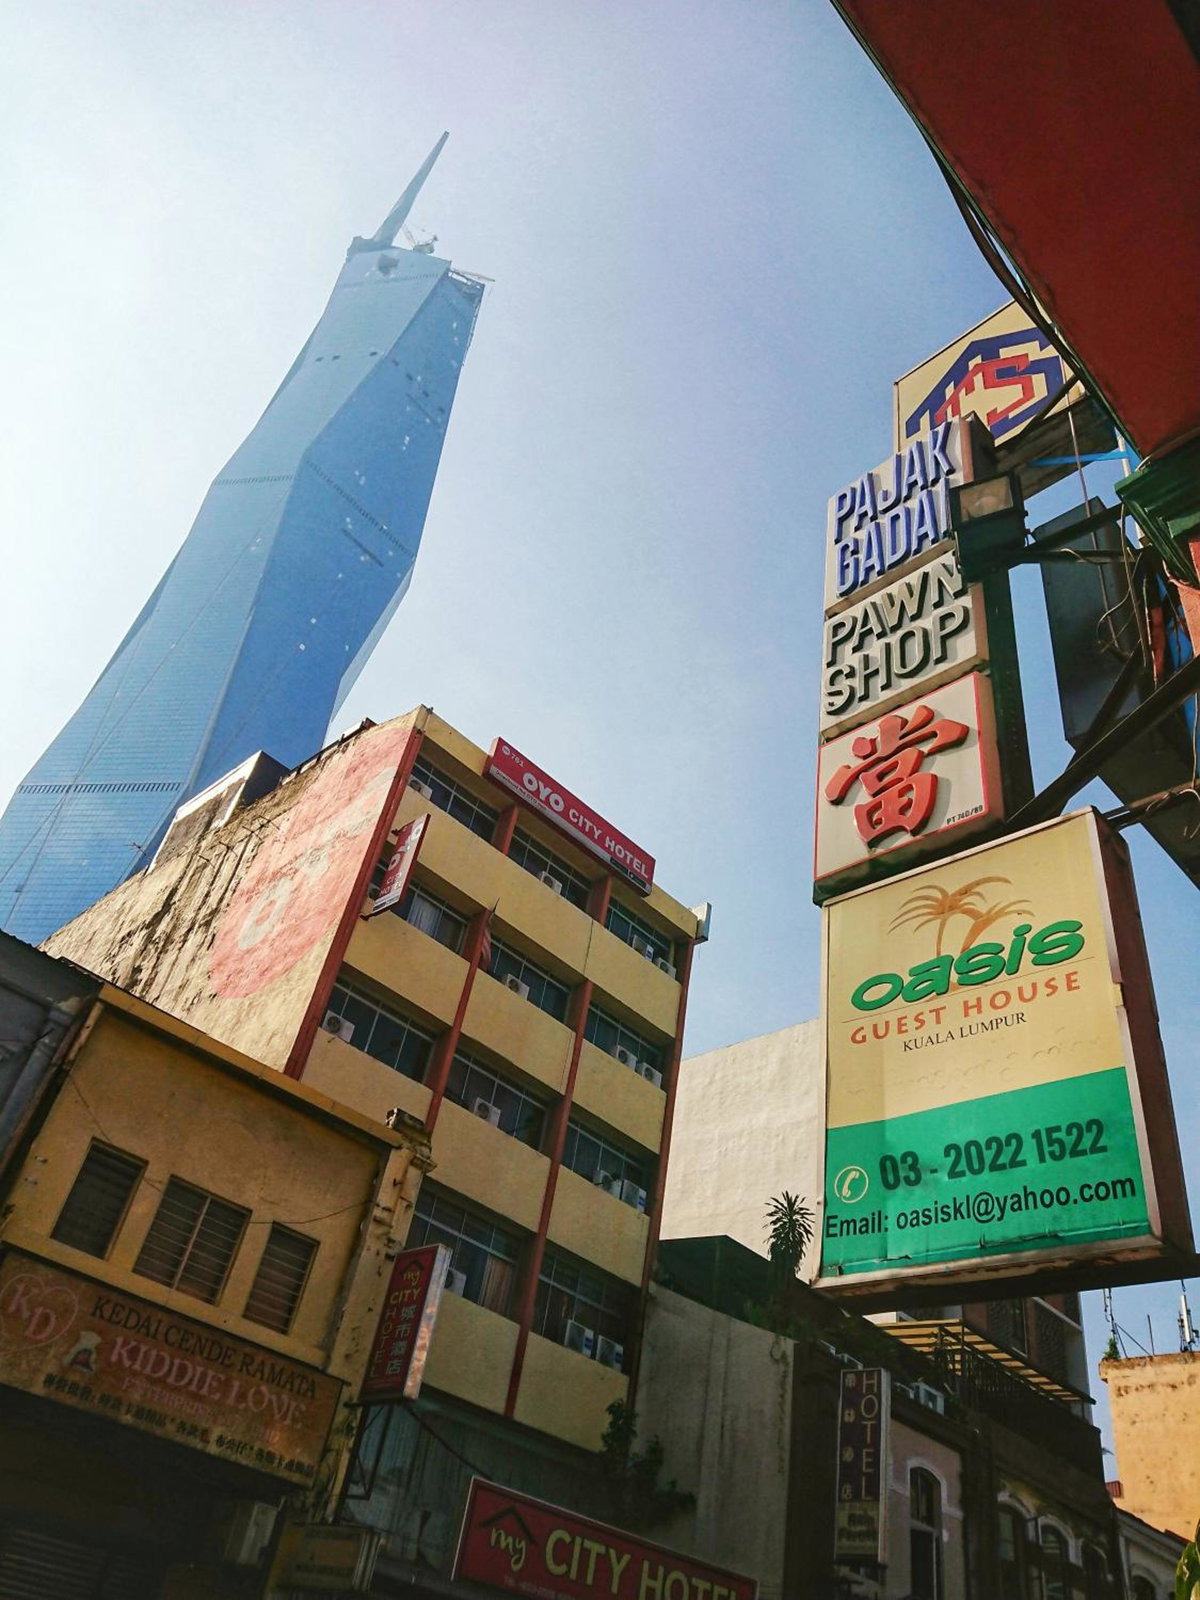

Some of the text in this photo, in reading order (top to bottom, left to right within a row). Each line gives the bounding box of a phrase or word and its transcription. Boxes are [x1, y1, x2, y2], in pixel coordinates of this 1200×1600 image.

[834, 421, 956, 544] PAJAK
[836, 477, 952, 598] GADAI
[826, 551, 968, 668] PAWN
[825, 605, 970, 715] SHOP
[824, 704, 970, 848] 當
[522, 772, 565, 812] OYO
[568, 808, 603, 839] CITY
[604, 835, 648, 878] HOTEL
[850, 971, 1081, 1044] GUEST HOUSE
[851, 920, 1085, 1011] oasis
[903, 1012, 1026, 1052] KUALA LUMPUR
[879, 1150, 922, 1190] 03
[943, 1132, 1027, 1180] 2022
[1031, 1119, 1108, 1163] 1522
[825, 1177, 1136, 1238] Email: oasiskl@yahoo.com
[390, 1288, 421, 1304] CITY
[90, 1299, 316, 1400] KEDAI CENDE RAMATA
[110, 1336, 225, 1400] KIDDIE
[230, 1380, 307, 1428] LOVE
[490, 1527, 526, 1572] my
[545, 1528, 631, 1595] CITY
[638, 1559, 738, 1600] HOT
